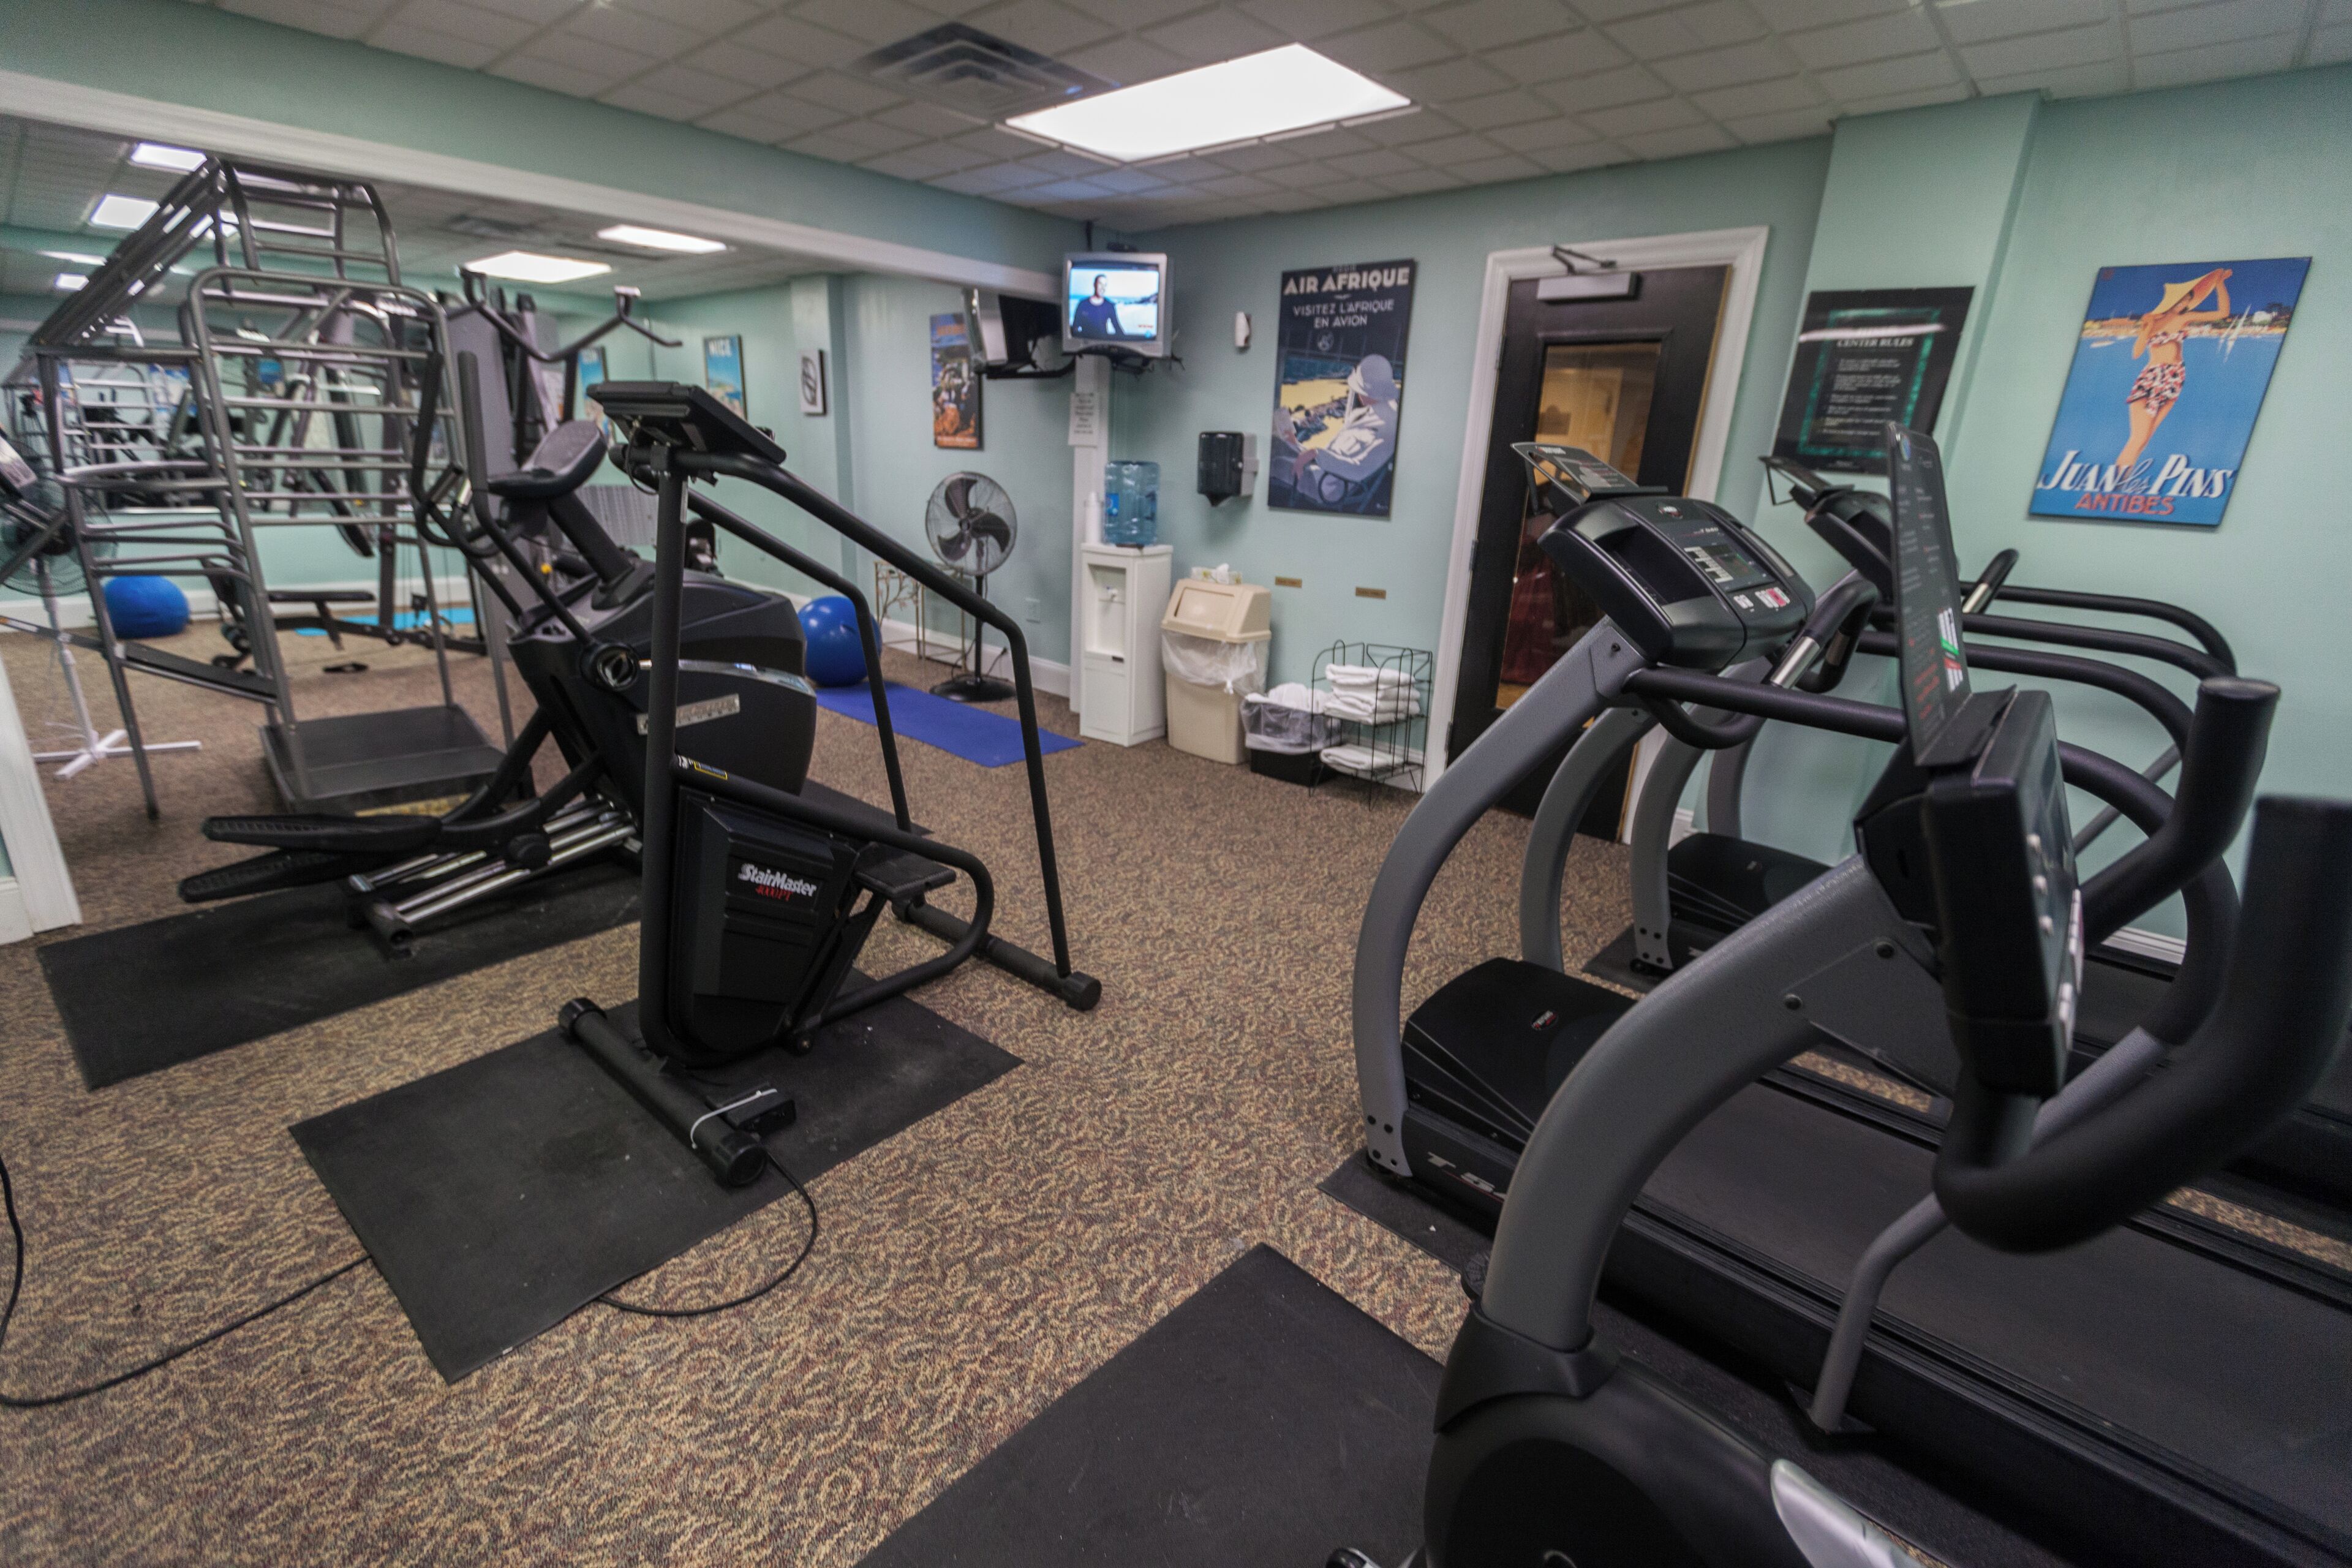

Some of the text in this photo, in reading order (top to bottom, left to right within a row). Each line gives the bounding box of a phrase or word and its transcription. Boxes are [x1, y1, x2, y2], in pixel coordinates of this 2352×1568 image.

[1283, 275, 1319, 295] AIR
[1321, 267, 1410, 292] AFRIQUE
[1292, 302, 1336, 316] VISITEZ
[1314, 315, 1368, 329] EN AVION
[2036, 450, 2130, 492] JUAN
[2146, 454, 2234, 498] PINS
[2075, 492, 2176, 516] ANTIBES
[737, 862, 817, 897] StairMaster
